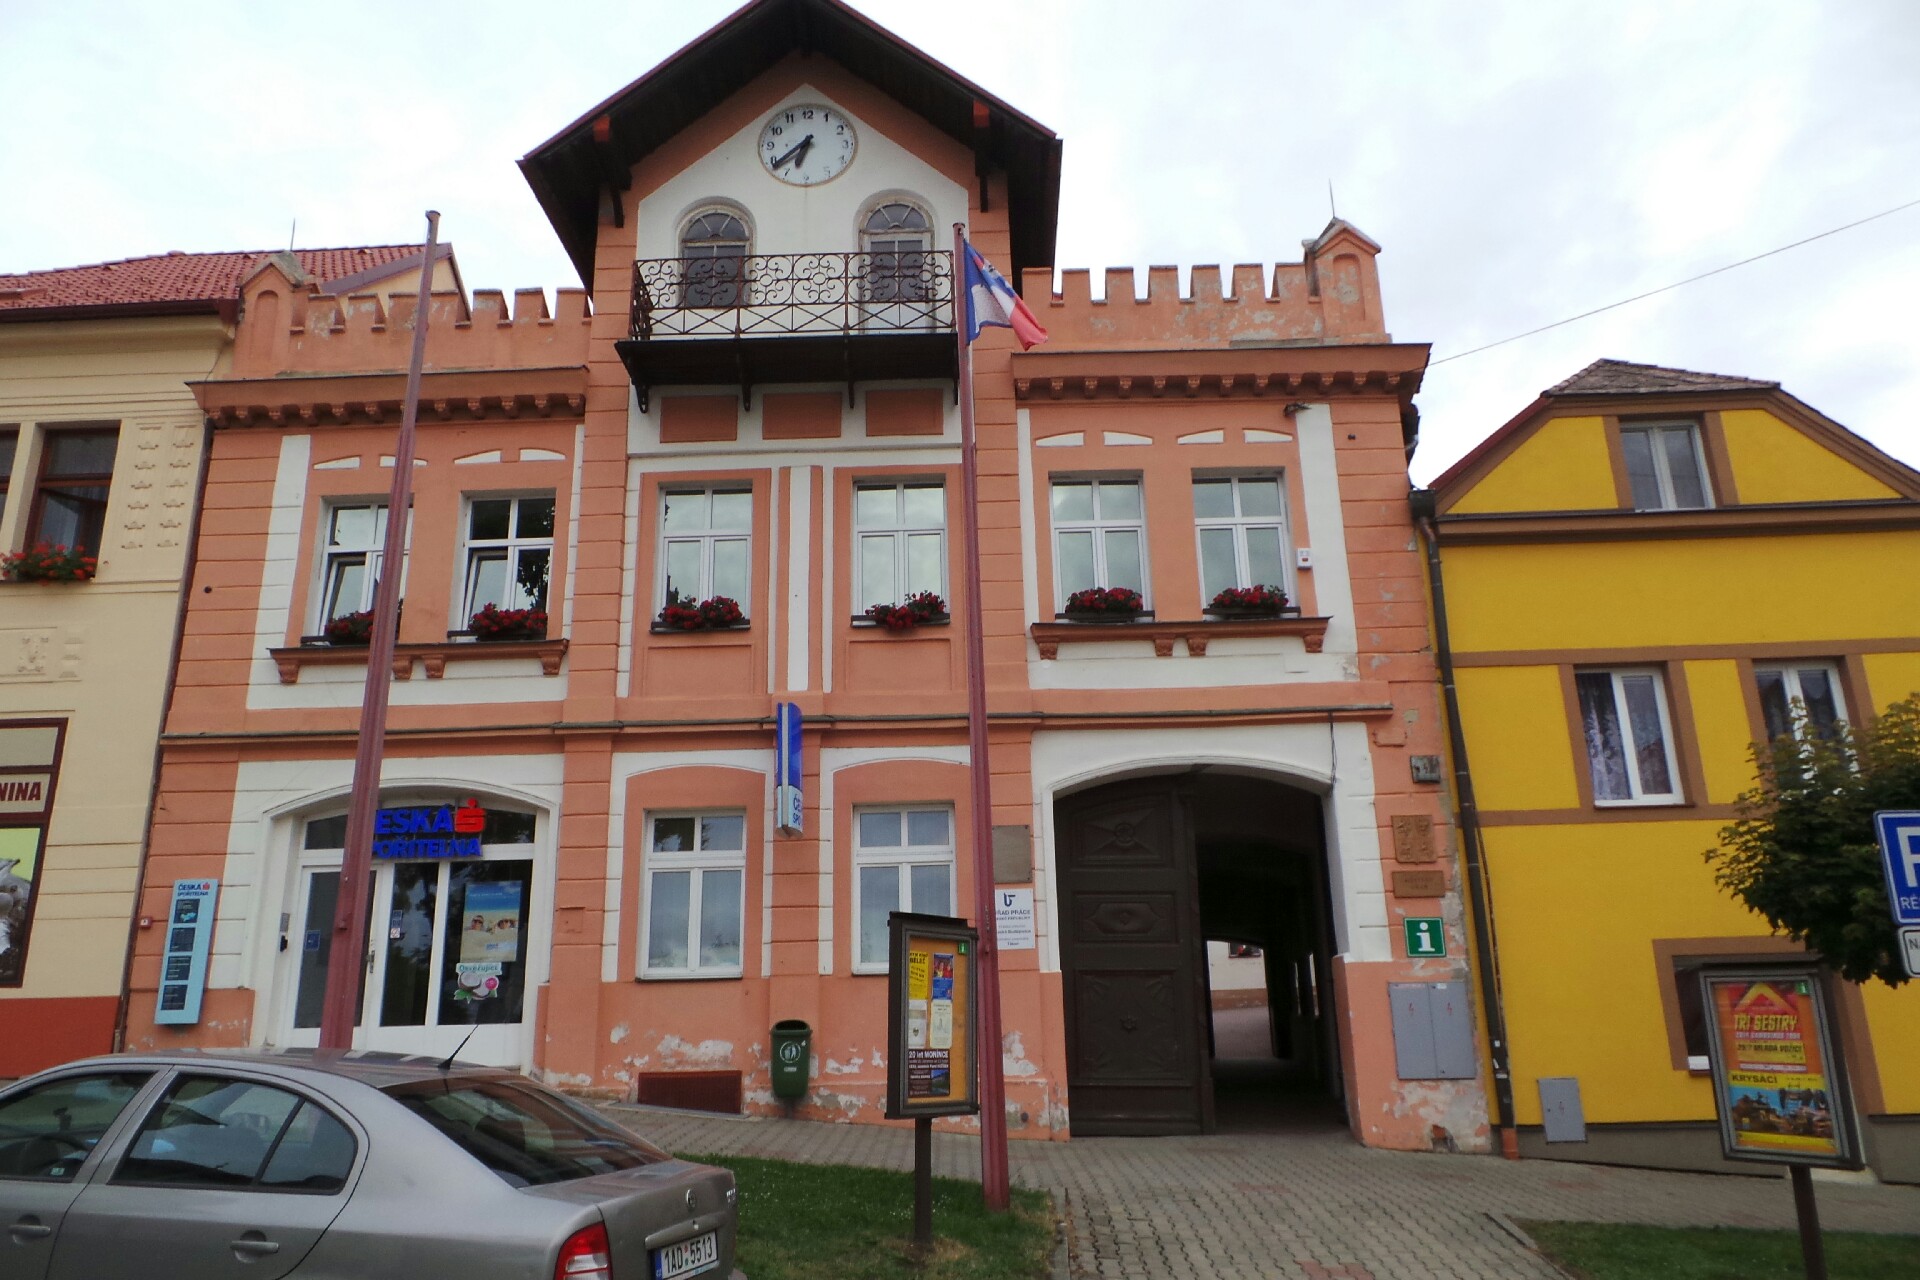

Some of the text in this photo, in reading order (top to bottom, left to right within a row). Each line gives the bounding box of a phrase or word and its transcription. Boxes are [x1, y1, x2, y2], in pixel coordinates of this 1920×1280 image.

[785, 112, 794, 123] 11
[802, 110, 814, 120] 12
[823, 113, 829, 122] 1
[771, 126, 782, 136] 10
[836, 125, 844, 135] 2
[766, 141, 775, 150] 9
[842, 139, 849, 149] 3
[783, 167, 790, 176] 7
[375, 803, 453, 834] ESKÁ
[372, 835, 482, 858] OŘITELNA
[1754, 1014, 1798, 1031] SESTRY
[665, 1237, 712, 1273] 1AD 5513
